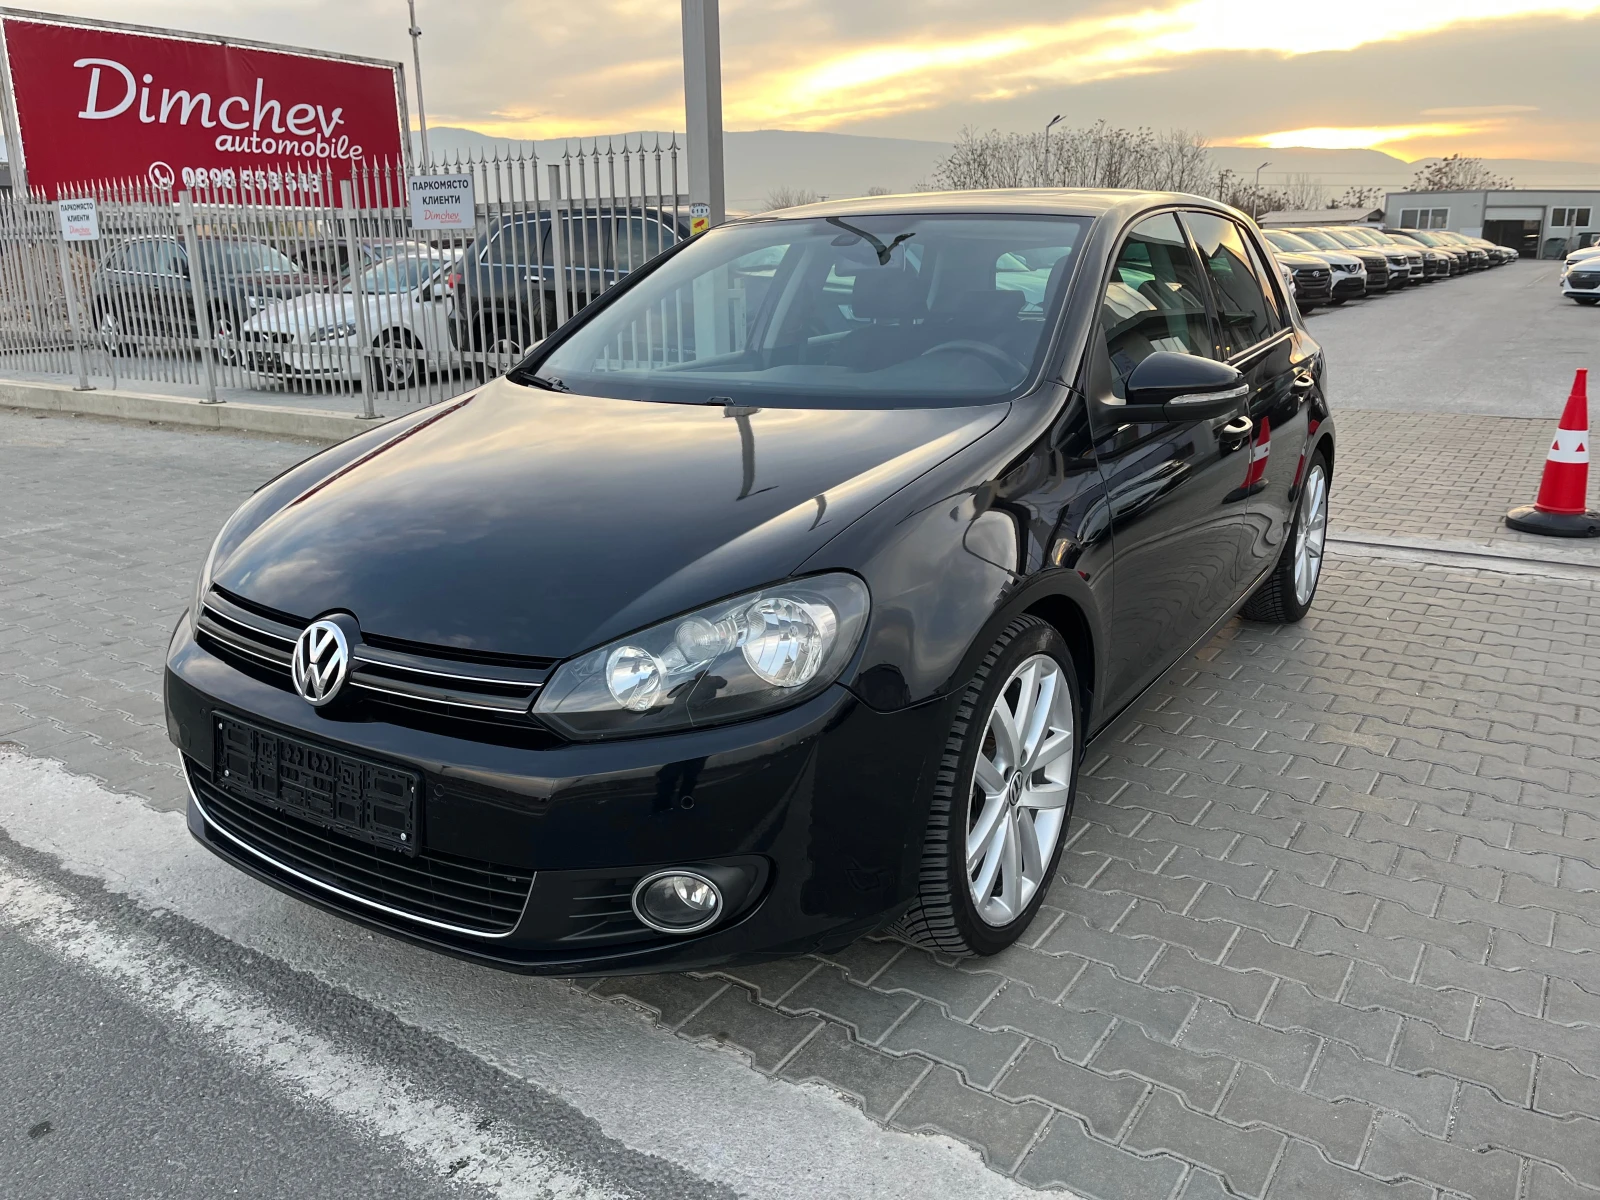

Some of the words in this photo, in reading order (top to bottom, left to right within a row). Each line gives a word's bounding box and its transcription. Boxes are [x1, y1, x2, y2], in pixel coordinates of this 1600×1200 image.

[73, 58, 345, 138] Dimchev
[214, 131, 363, 160] automobile
[412, 179, 469, 191] ПАРКОМЯСТО
[422, 195, 461, 205] КЛИЕНТИ
